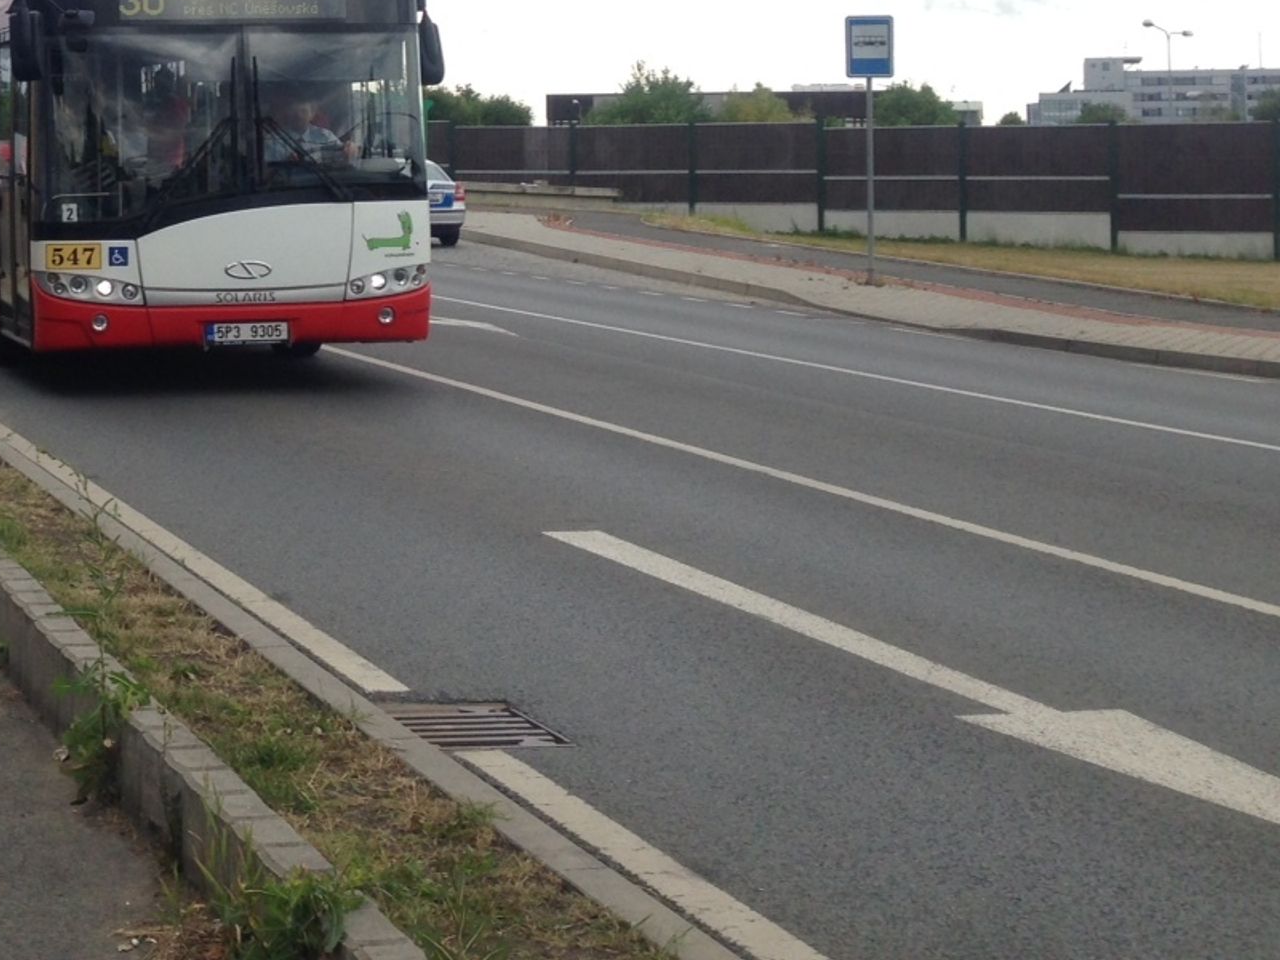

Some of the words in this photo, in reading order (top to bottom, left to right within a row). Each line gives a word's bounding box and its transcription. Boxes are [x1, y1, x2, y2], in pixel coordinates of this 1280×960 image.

[66, 207, 74, 221] 2
[51, 247, 95, 266] 547
[215, 291, 276, 303] SOLARIS
[216, 325, 241, 339] 5P3
[250, 324, 282, 338] 9305
